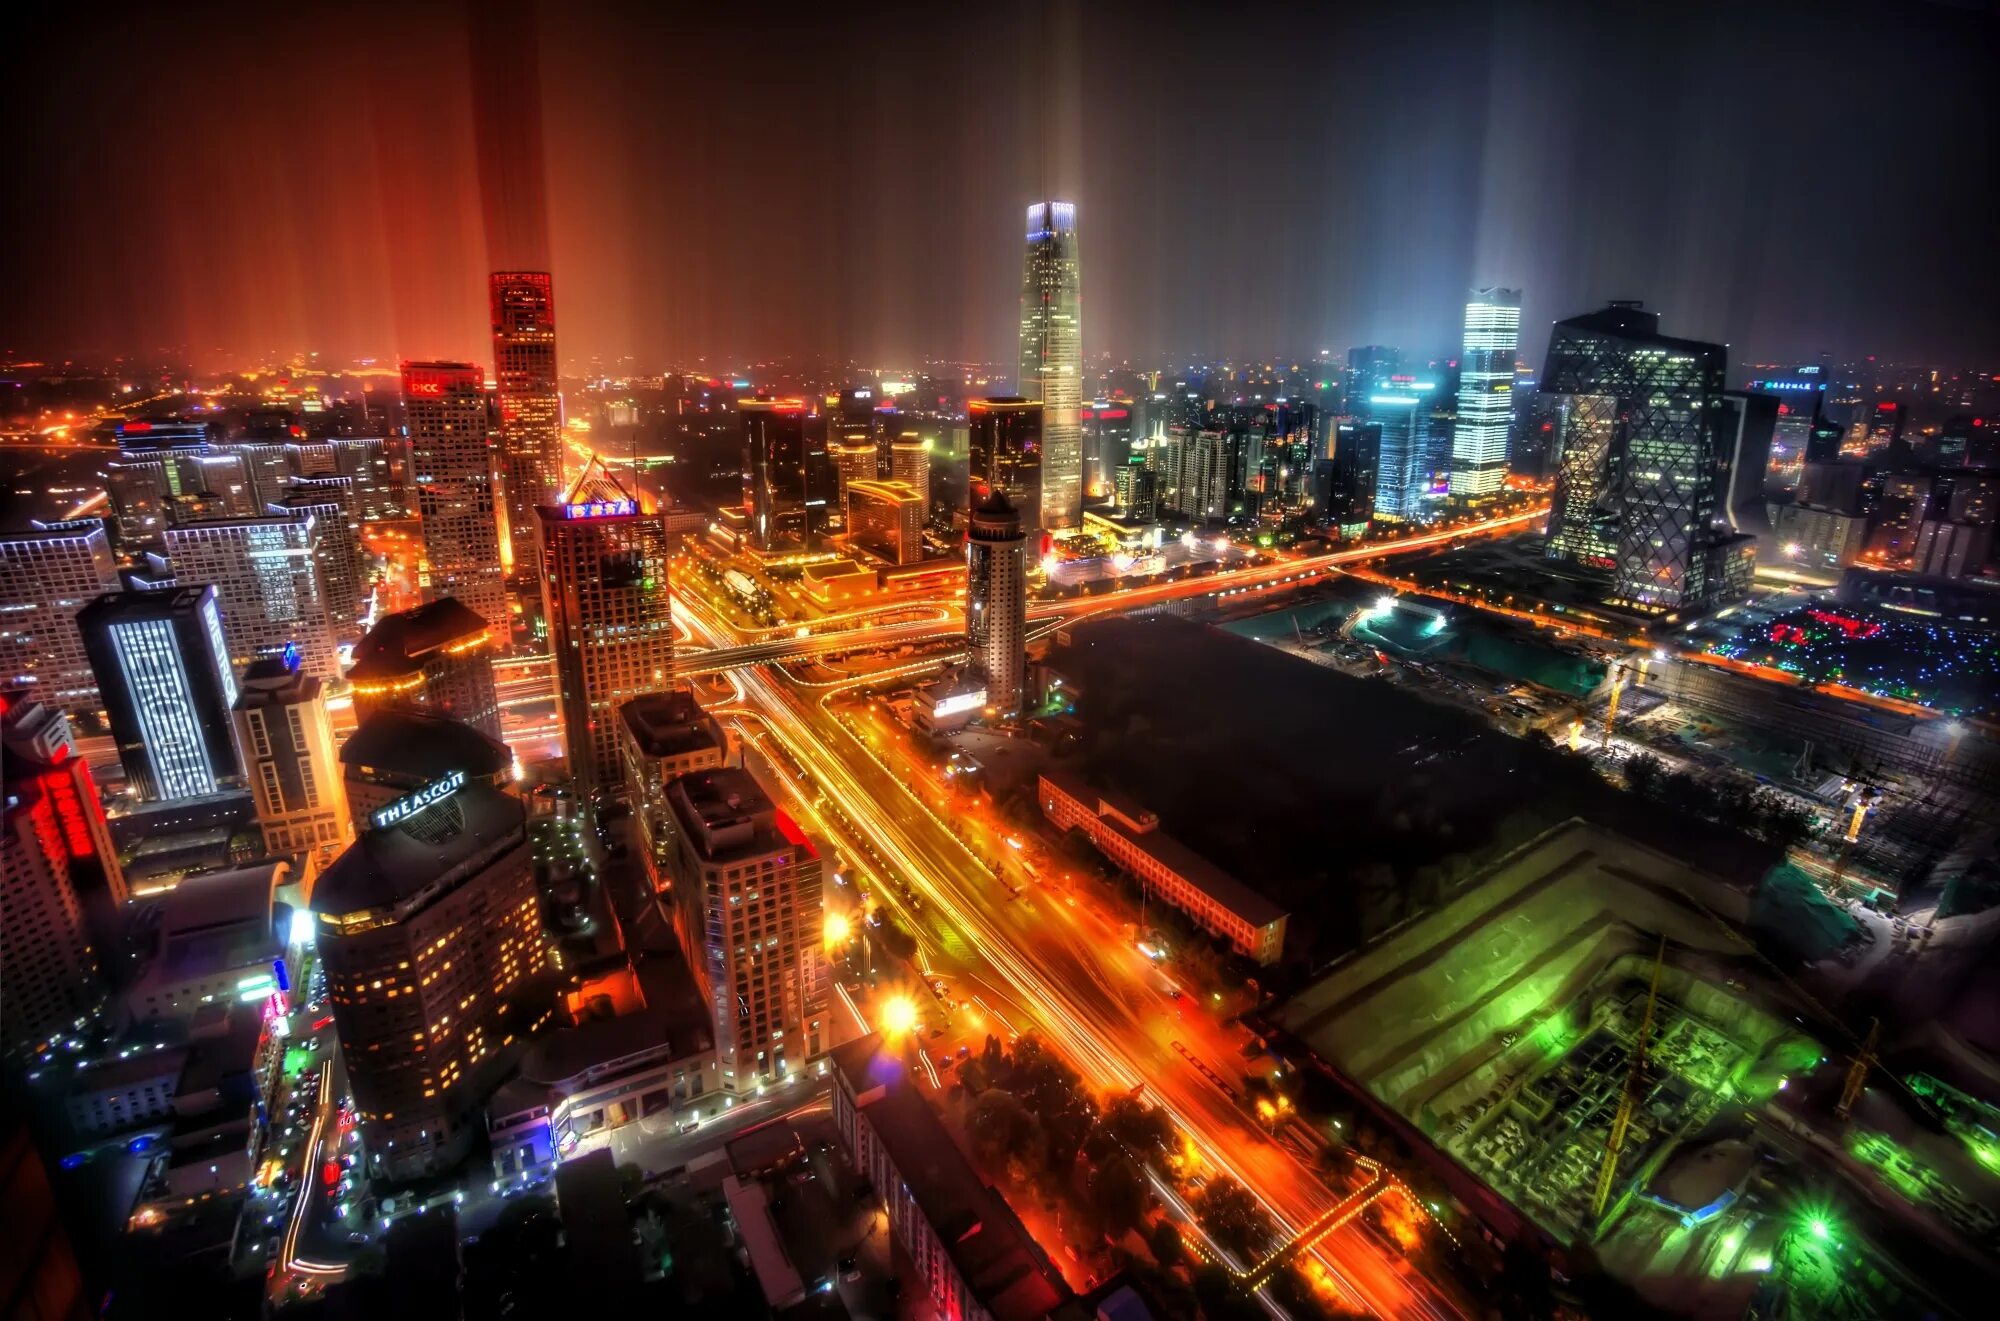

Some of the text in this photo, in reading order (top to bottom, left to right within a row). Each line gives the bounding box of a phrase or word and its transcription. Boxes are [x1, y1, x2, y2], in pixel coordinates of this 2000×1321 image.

[411, 383, 439, 393] PICC
[377, 771, 464, 826] THE ASCOTT
